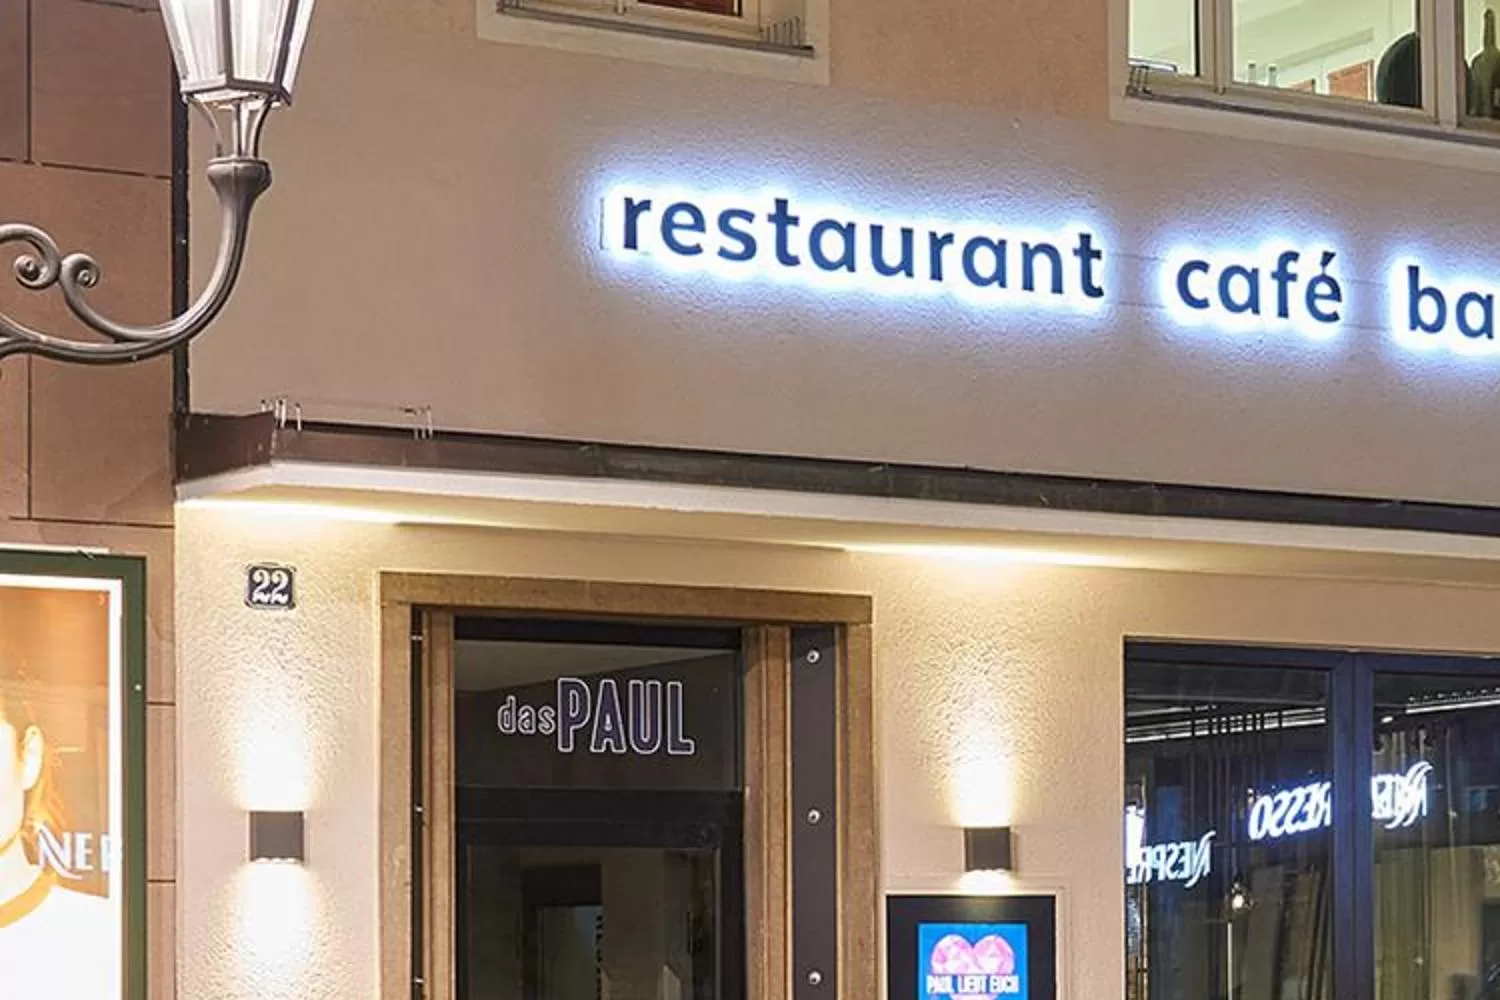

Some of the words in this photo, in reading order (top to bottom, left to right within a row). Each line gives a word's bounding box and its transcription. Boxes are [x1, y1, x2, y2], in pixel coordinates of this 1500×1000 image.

[621, 196, 1104, 299] restaurant
[1174, 250, 1344, 323] café
[252, 569, 289, 603] 22
